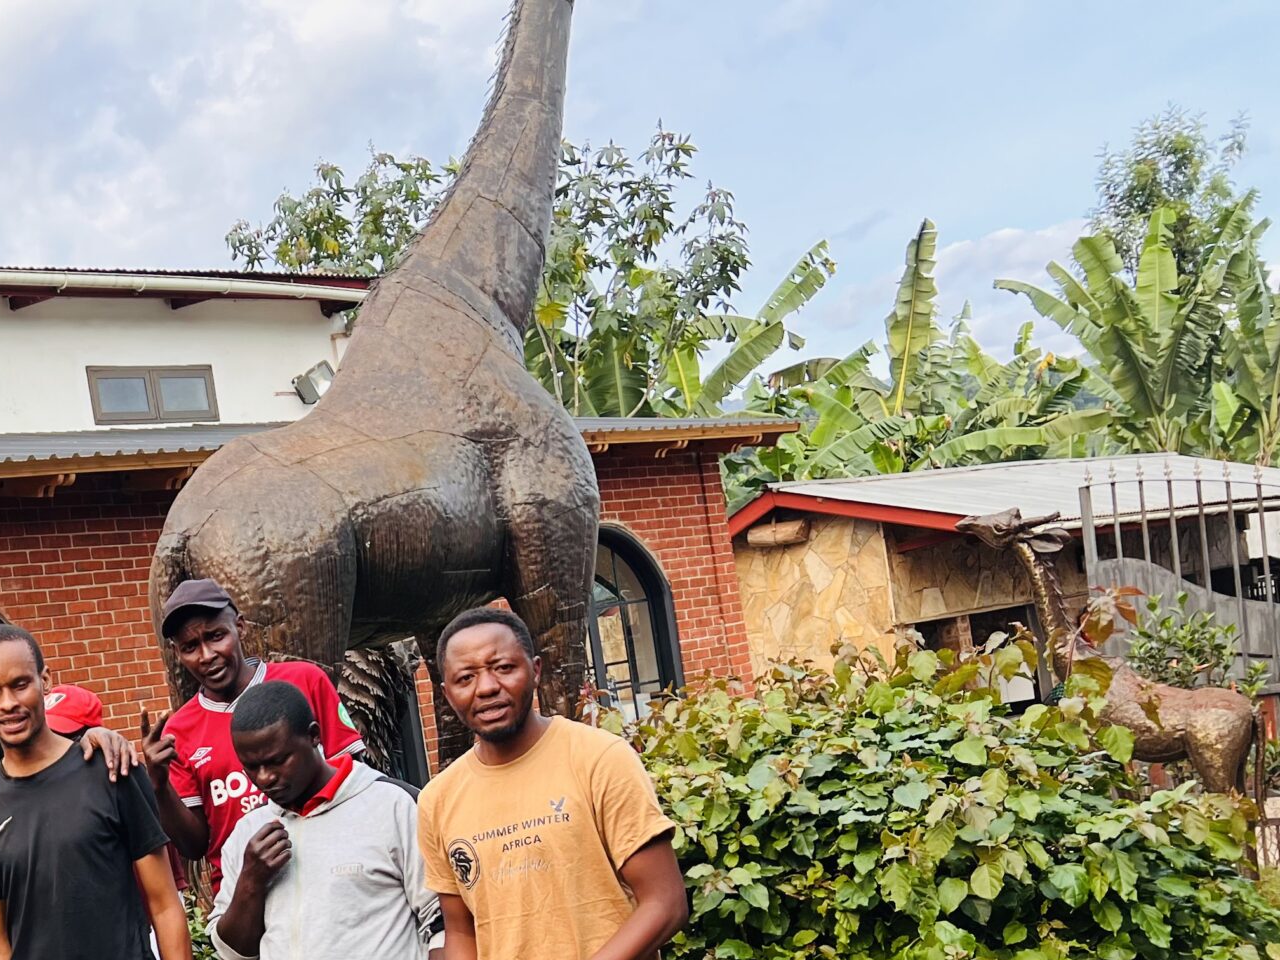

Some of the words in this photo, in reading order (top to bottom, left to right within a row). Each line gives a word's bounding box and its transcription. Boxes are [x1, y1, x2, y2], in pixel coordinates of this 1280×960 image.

[472, 823, 519, 844] SUMMER
[522, 812, 570, 830] WINTER
[501, 834, 542, 853] AFRICA
